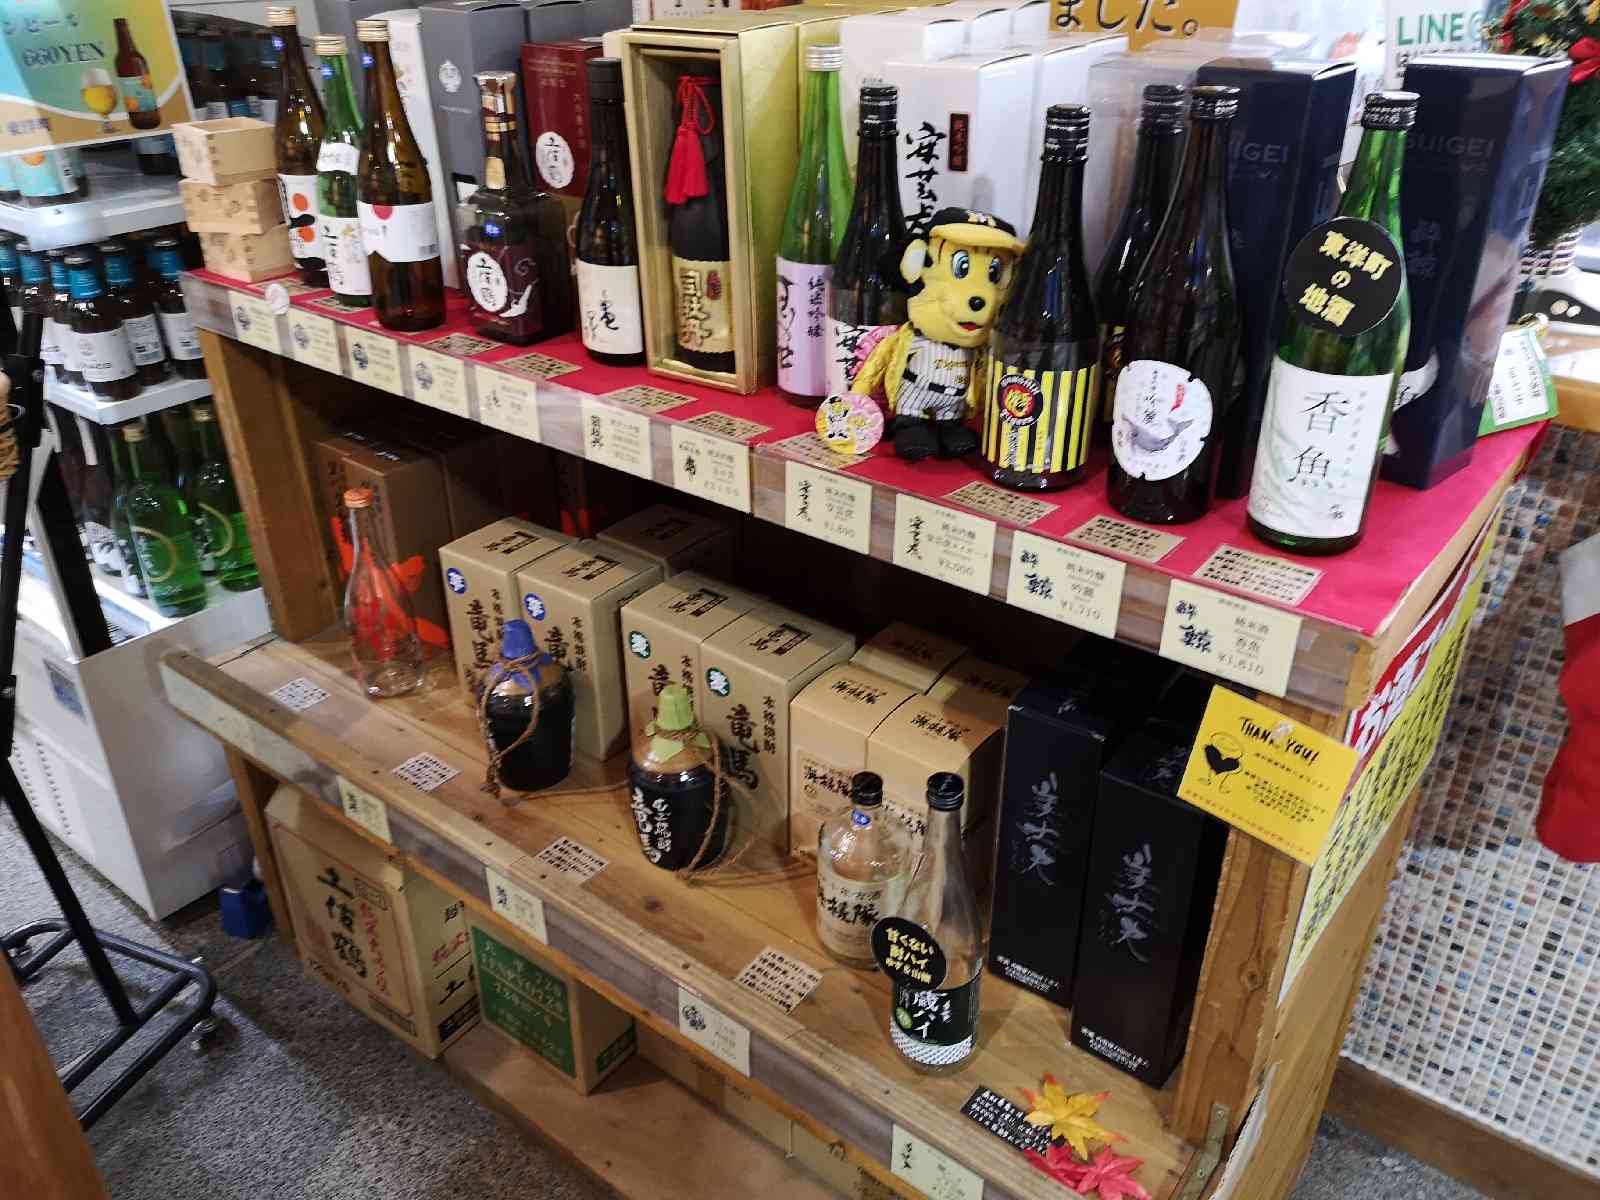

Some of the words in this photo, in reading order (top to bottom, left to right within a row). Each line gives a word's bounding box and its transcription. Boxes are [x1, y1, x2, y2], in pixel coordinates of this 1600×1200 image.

[1319, 230, 1394, 281] 東洋町
[1330, 270, 1352, 289] の
[1298, 283, 1356, 327] 地酒
[1286, 391, 1352, 489] 香魚
[1284, 736, 1321, 766] YOU!
